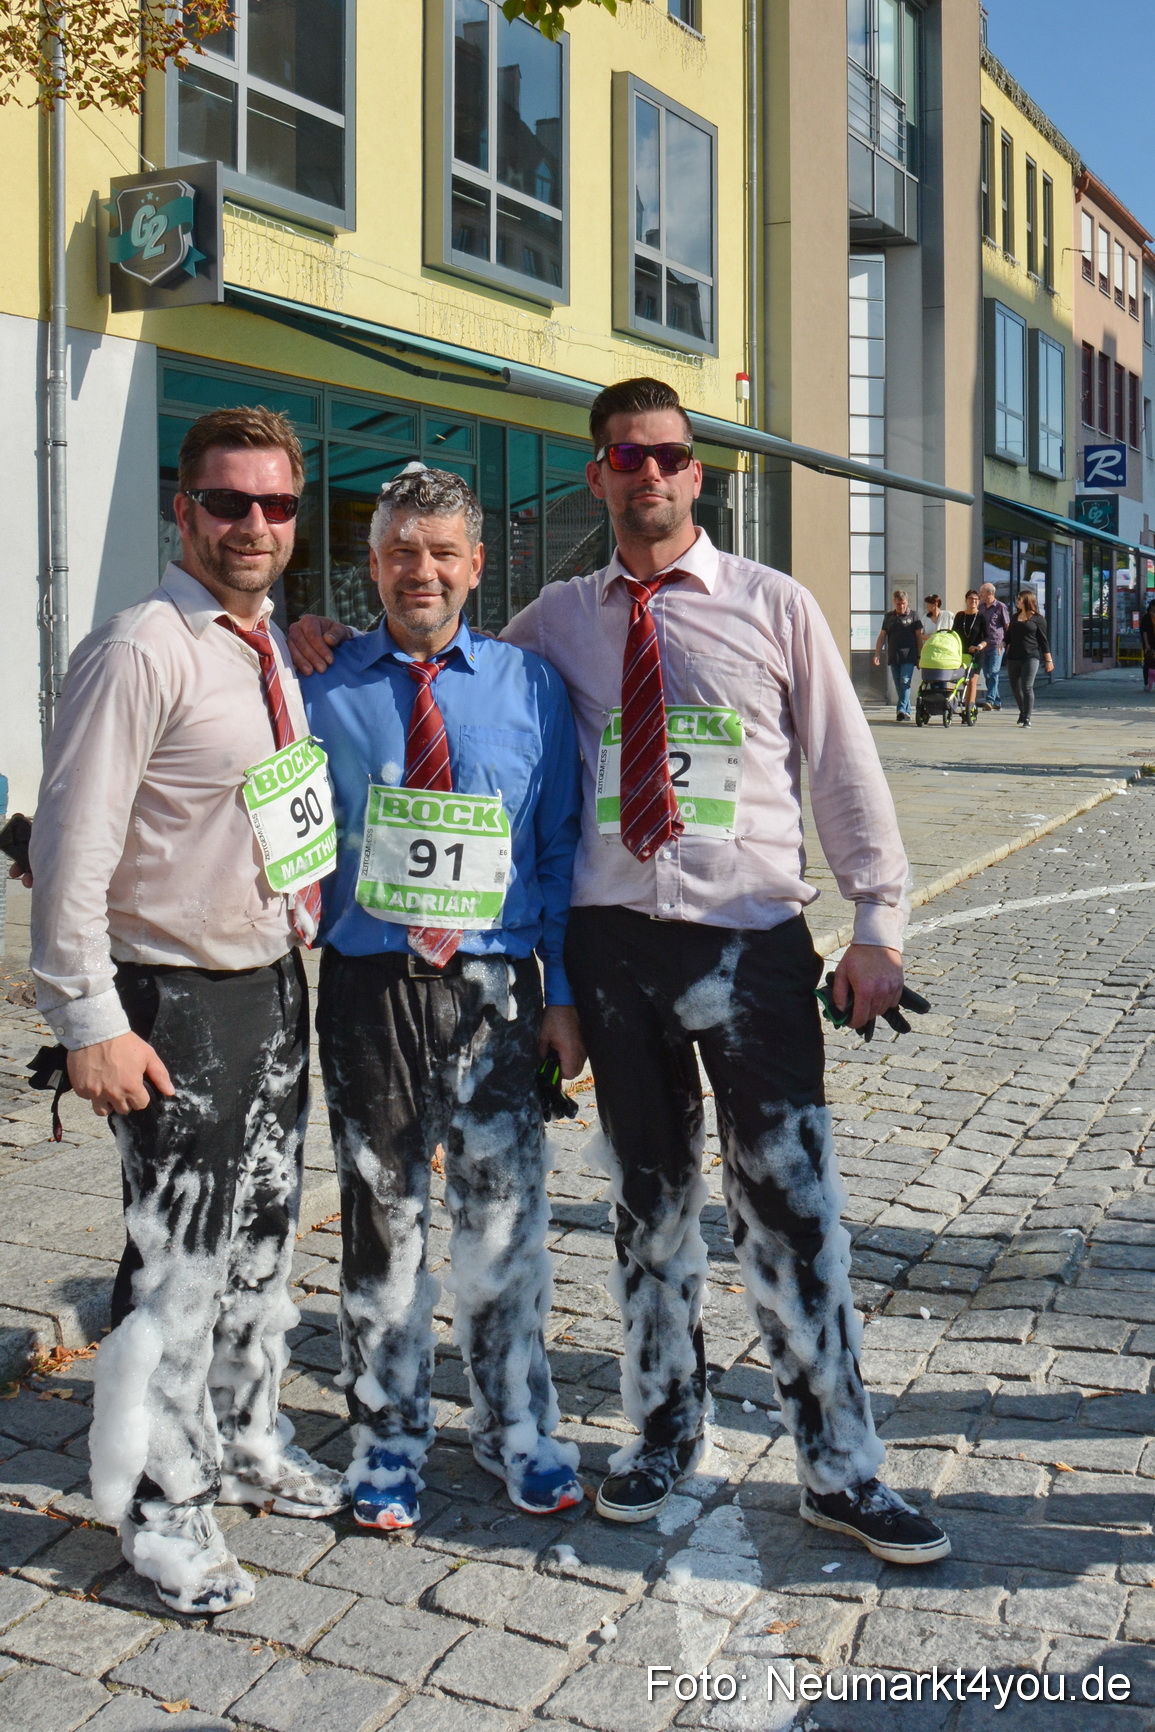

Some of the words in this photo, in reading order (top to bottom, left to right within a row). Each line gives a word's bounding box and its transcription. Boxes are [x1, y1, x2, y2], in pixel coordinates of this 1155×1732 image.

[131, 204, 168, 260] G2
[1088, 506, 1103, 524] G2
[252, 742, 319, 802] BOCK
[727, 757, 738, 765] E6
[290, 786, 324, 839] 90
[377, 792, 504, 832] BOCK
[280, 829, 337, 881] MATTHIA
[408, 839, 465, 882] 91
[499, 849, 508, 857] E6
[388, 890, 476, 913] ADRIAN
